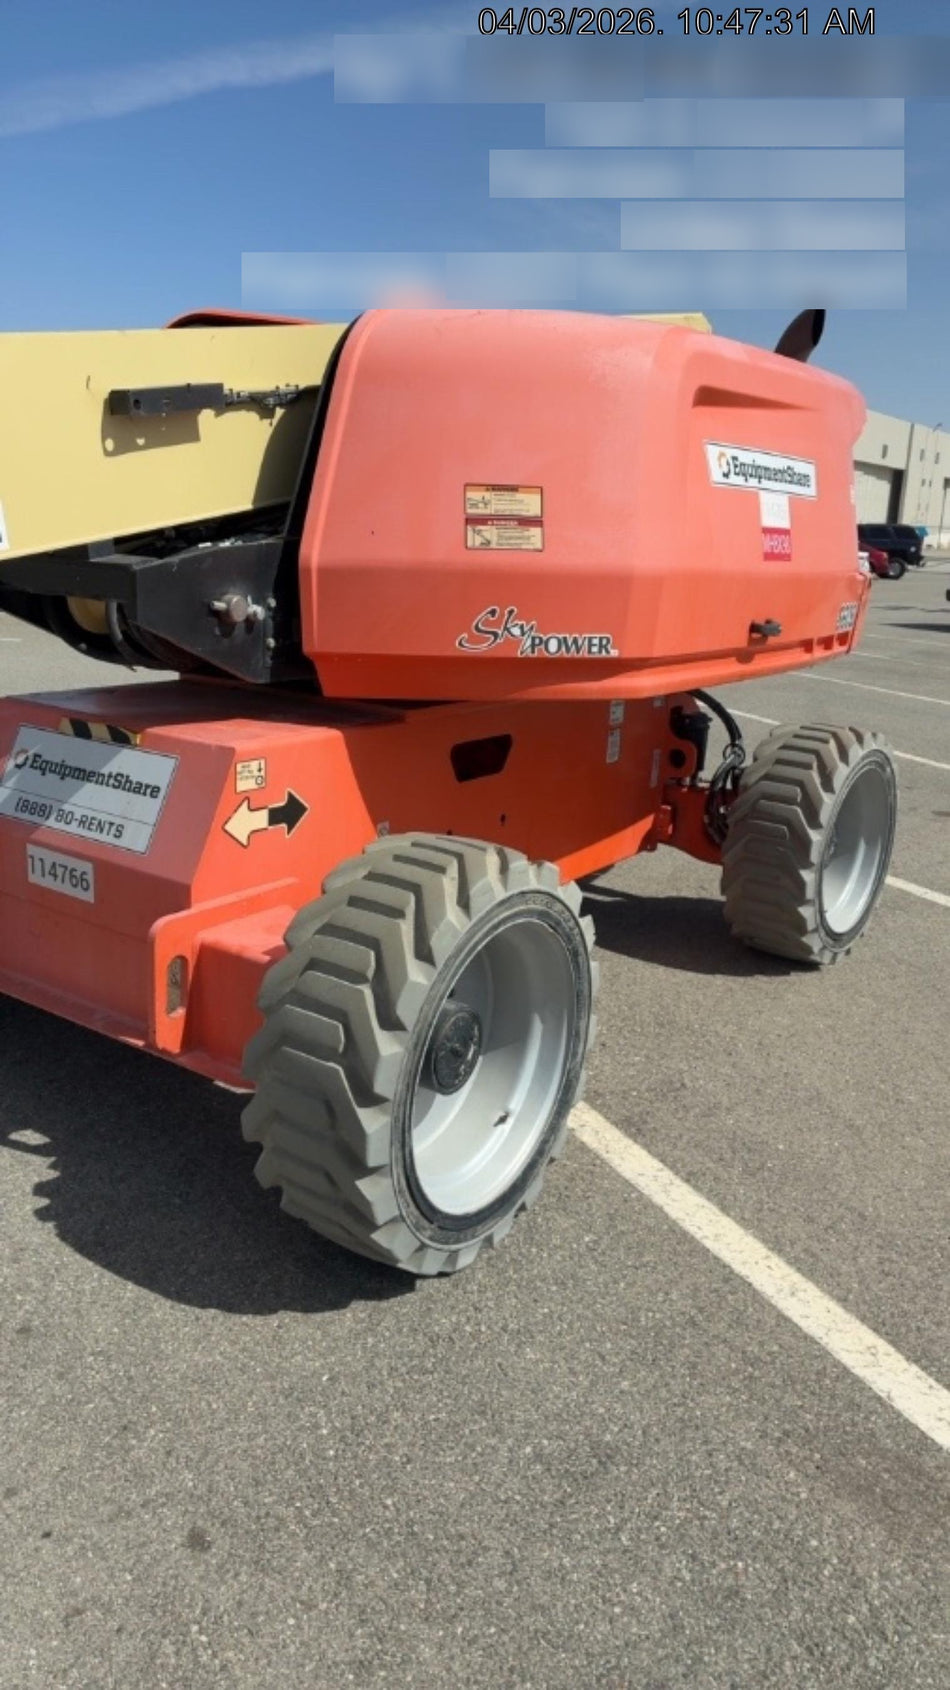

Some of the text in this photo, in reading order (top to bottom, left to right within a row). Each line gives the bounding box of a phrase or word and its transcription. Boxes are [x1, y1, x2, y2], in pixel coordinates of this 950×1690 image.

[731, 455, 811, 488] EquipmentShare
[456, 606, 612, 657] Sky POWER
[29, 753, 162, 799] EquipmentShare
[15, 796, 54, 821] (888)
[28, 854, 91, 892] 114766
